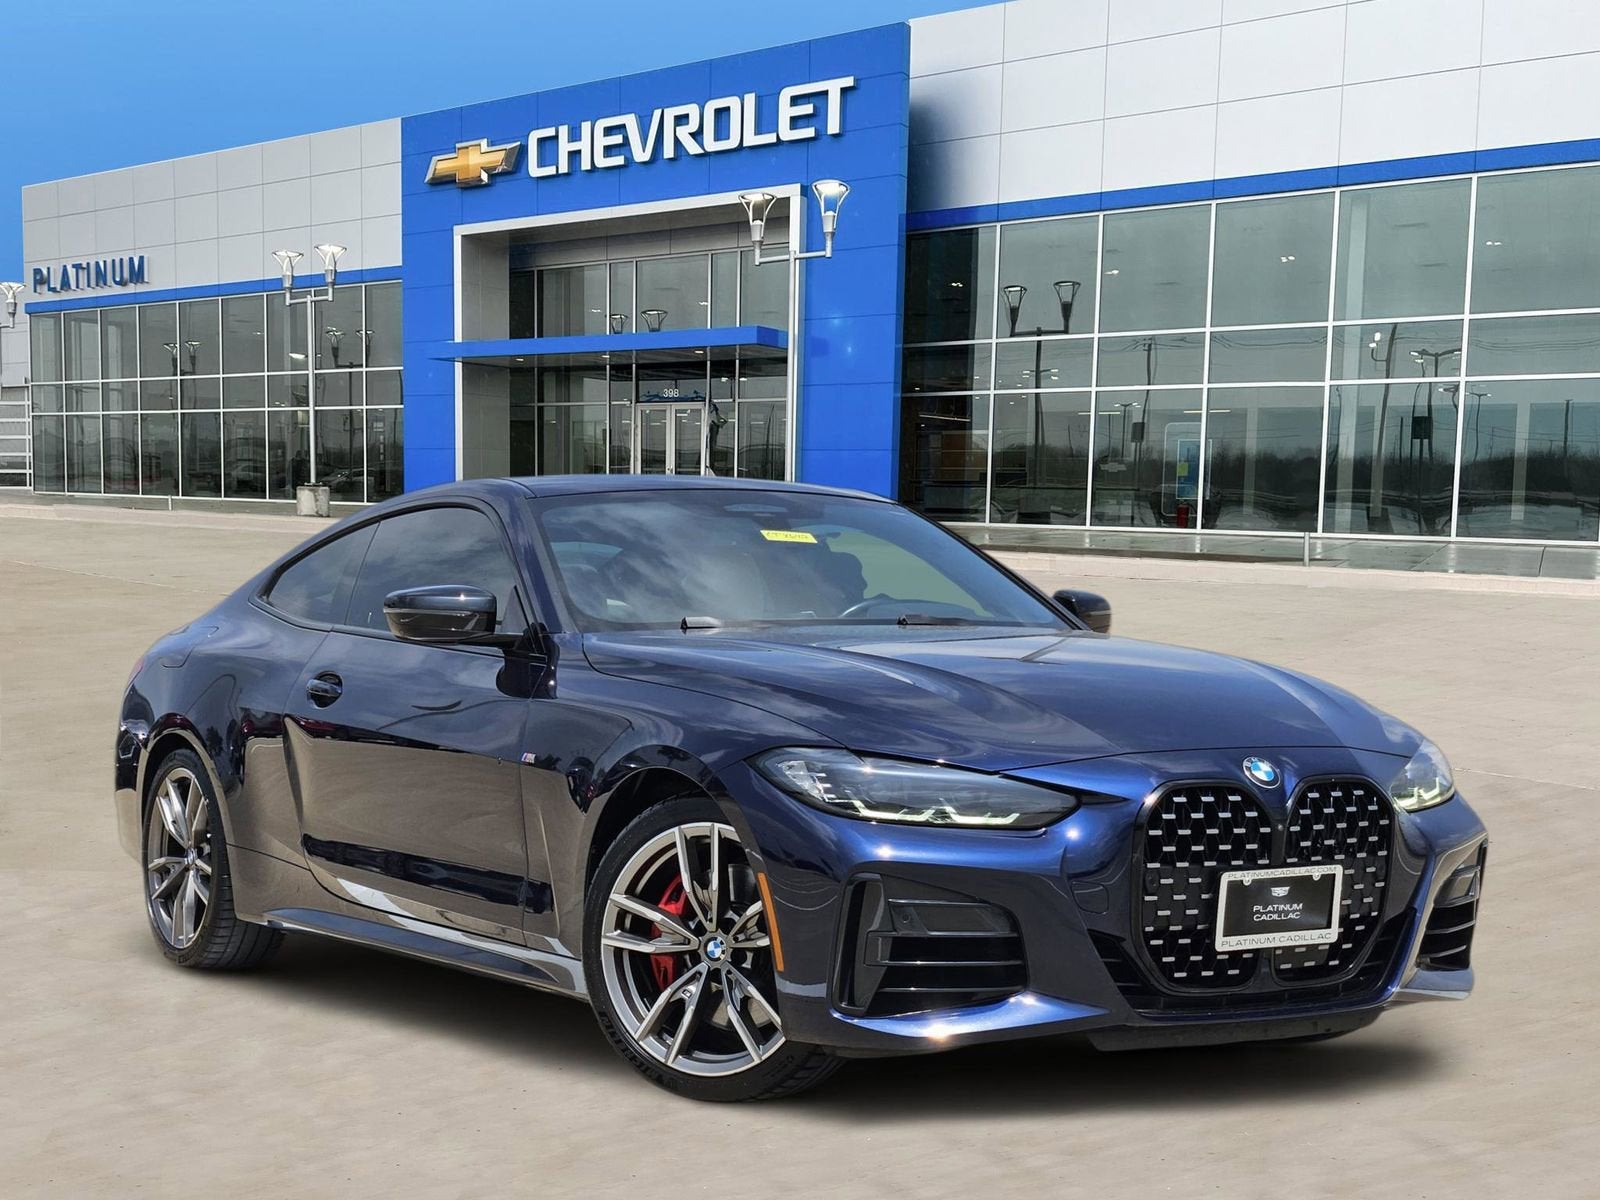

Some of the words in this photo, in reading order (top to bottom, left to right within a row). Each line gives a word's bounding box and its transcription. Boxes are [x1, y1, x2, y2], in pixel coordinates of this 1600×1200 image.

[528, 76, 855, 179] CHEVROLET
[32, 255, 146, 294] PLATINUM
[663, 388, 680, 398] 398
[1253, 903, 1303, 912] PLATINUM
[1253, 912, 1301, 921] CADILLAC
[1221, 936, 1276, 948] PLATINUM
[1279, 932, 1332, 944] CADILLAC
